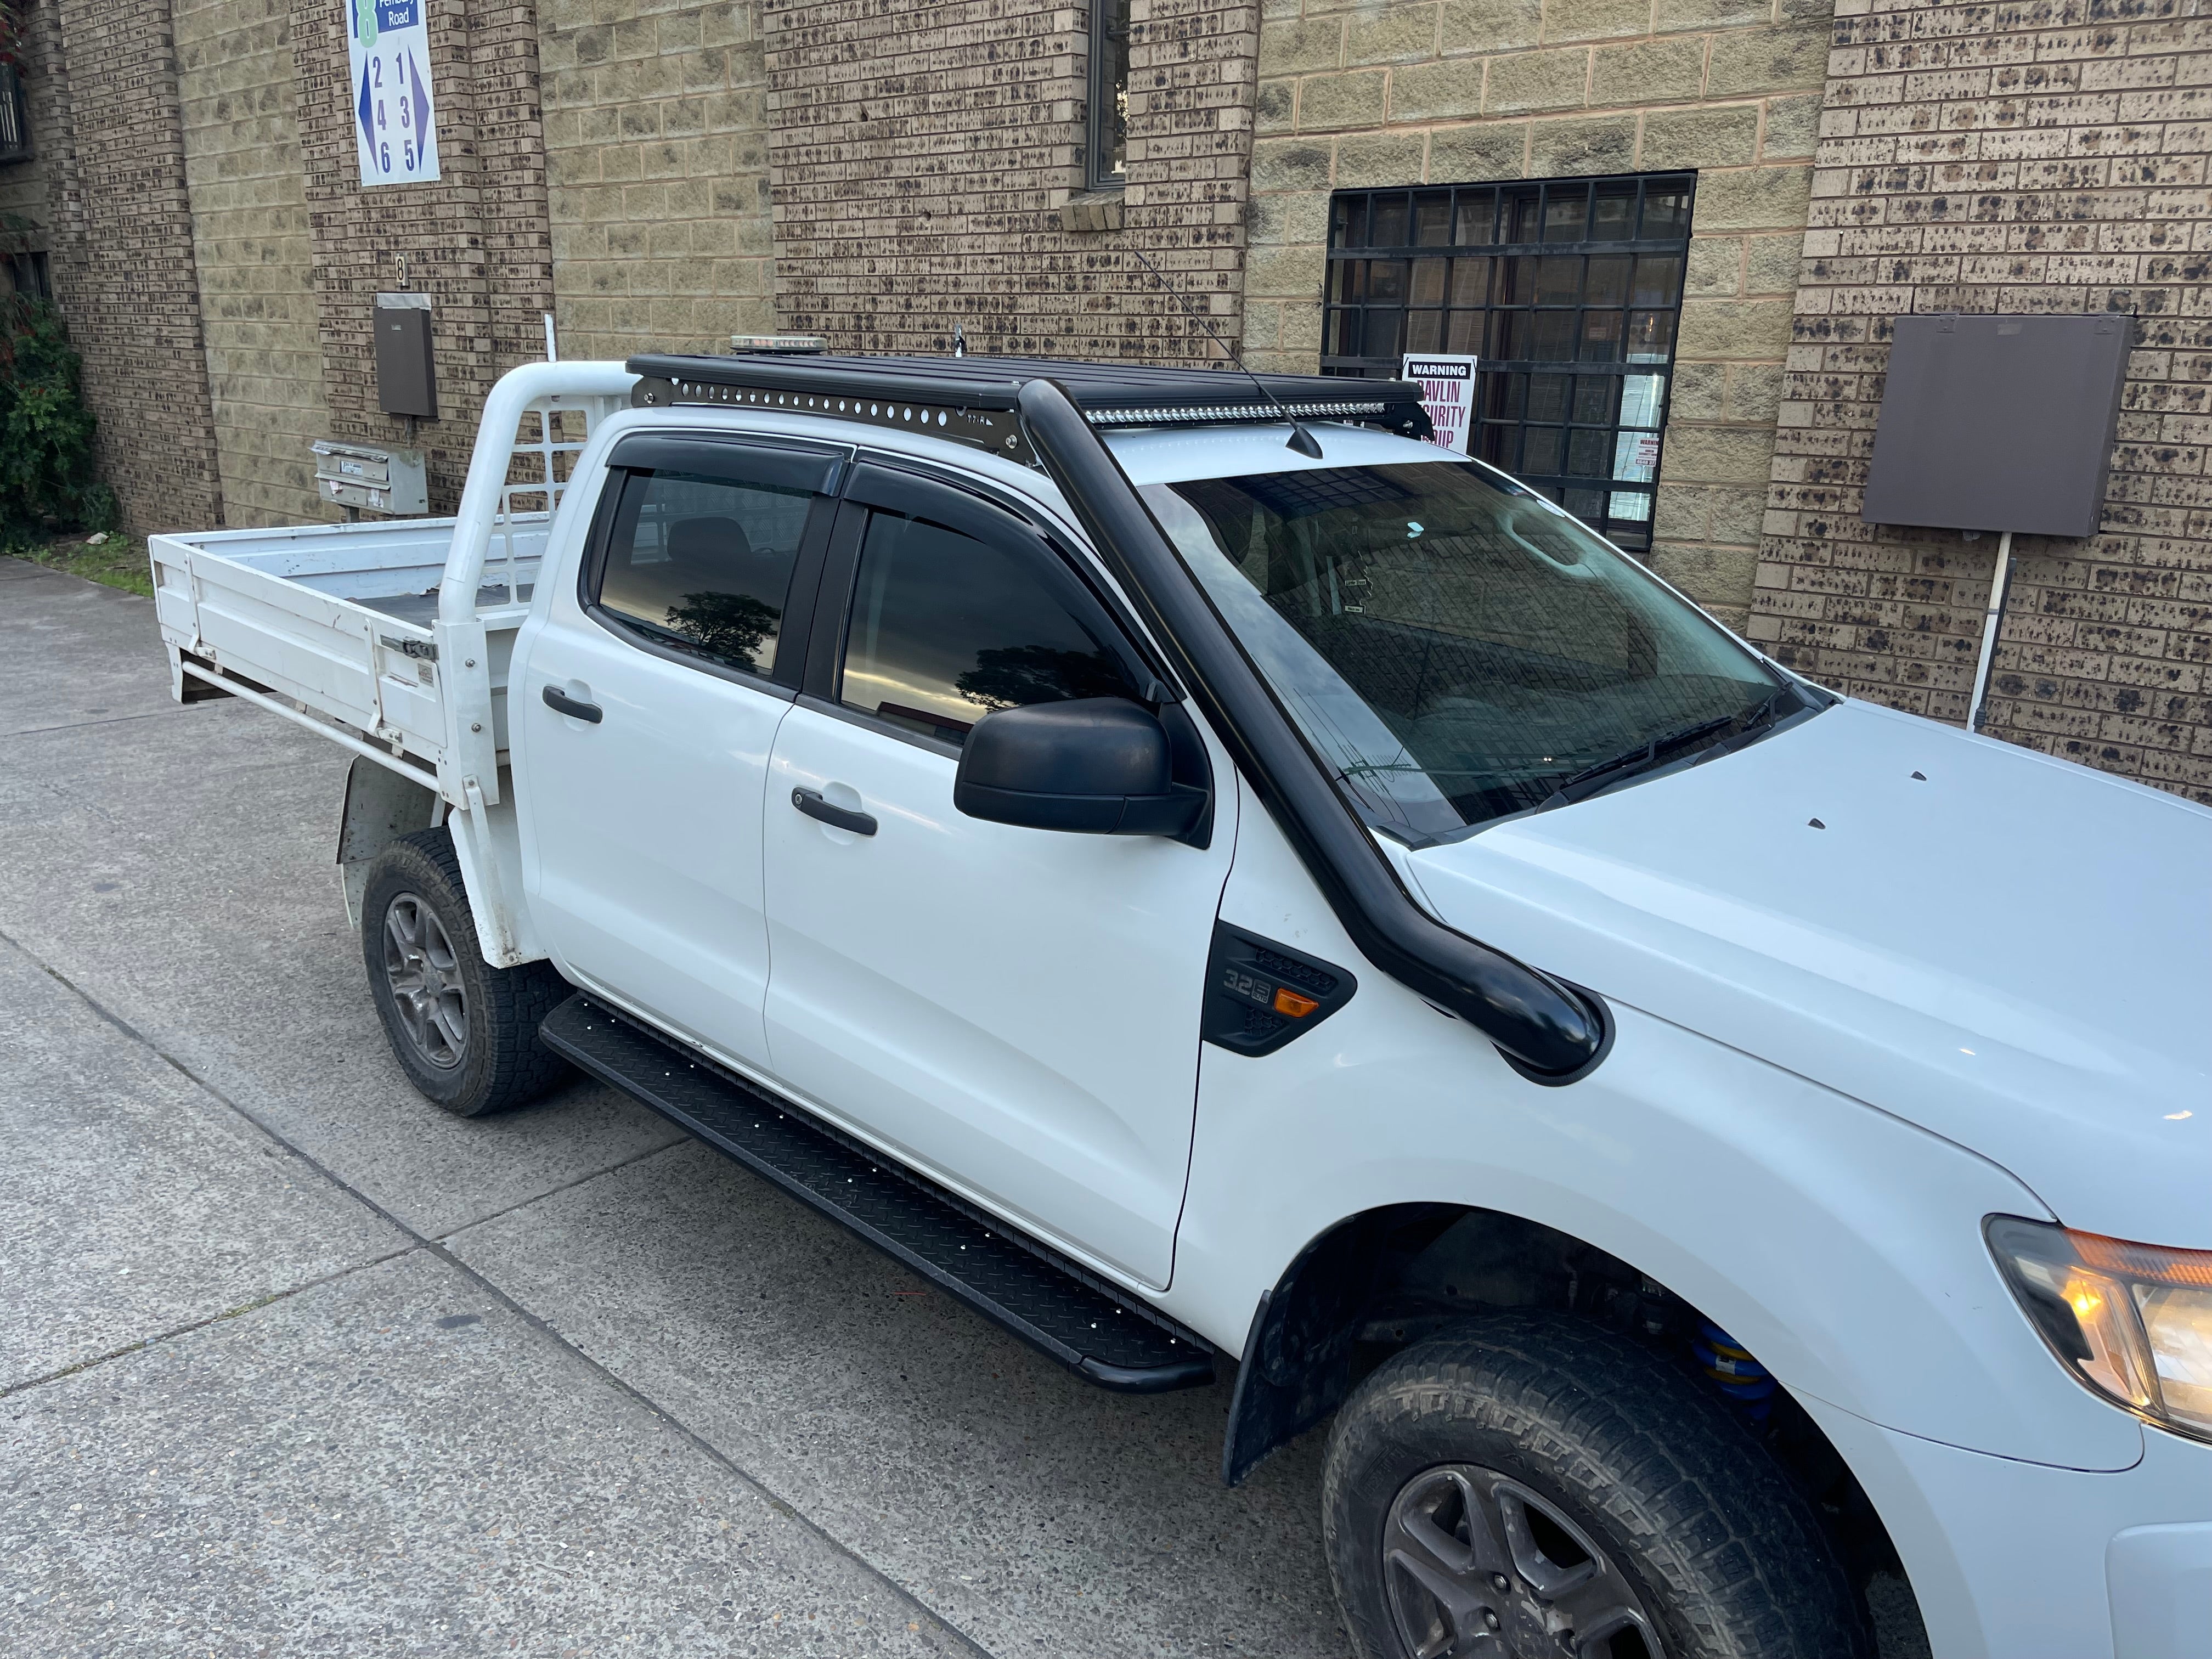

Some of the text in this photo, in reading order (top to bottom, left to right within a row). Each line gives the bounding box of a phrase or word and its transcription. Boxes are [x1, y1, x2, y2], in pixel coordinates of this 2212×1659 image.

[388, 7, 409, 26] Road
[373, 53, 404, 88] 2 1
[377, 96, 409, 131] 4 3
[381, 140, 414, 173] 6 5
[397, 258, 403, 280] 8
[1412, 364, 1466, 376] WARNING
[1421, 404, 1466, 428] URITY
[1223, 969, 1252, 995] 3.2
[1252, 992, 1267, 1003] AUTO
